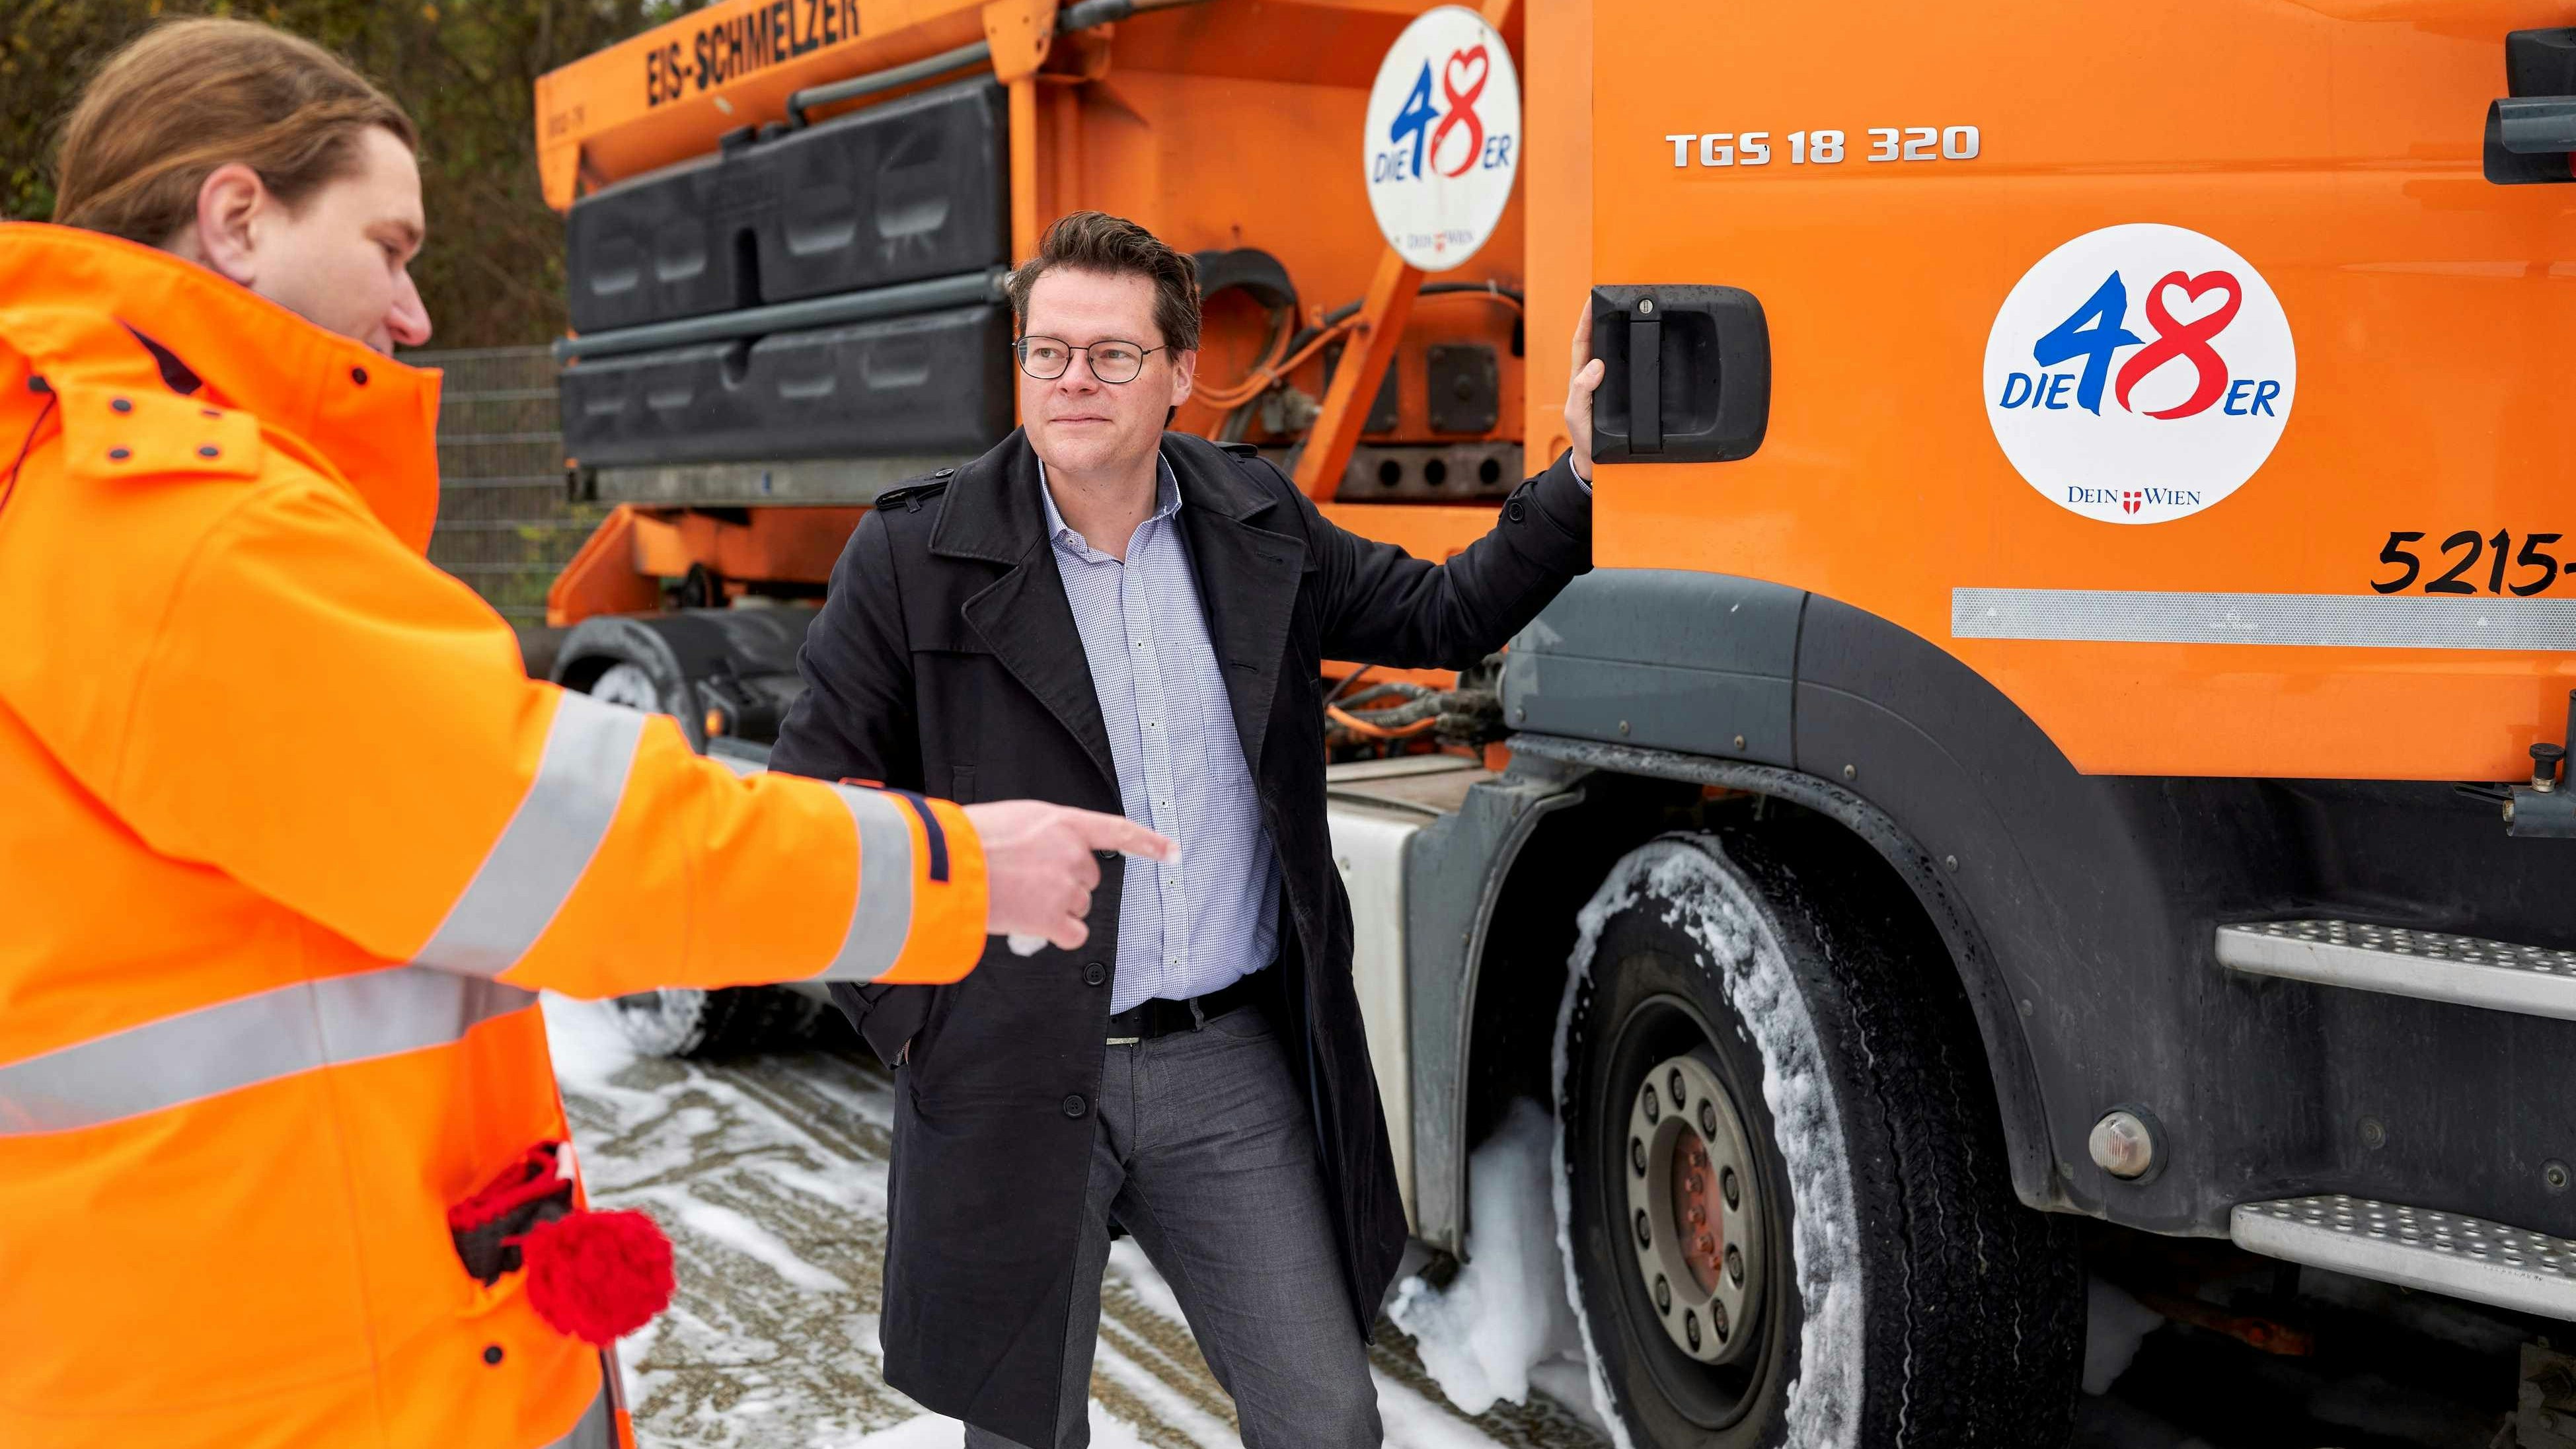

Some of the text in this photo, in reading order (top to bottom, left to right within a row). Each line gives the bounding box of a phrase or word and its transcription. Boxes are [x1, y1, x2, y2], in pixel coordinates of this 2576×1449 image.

[1373, 44, 1511, 183] DIE 48 ER
[1665, 126, 1980, 167] TGS 18 320
[1999, 270, 2281, 420] DIE 48 ER
[2068, 486, 2201, 505] DEIN WIEN
